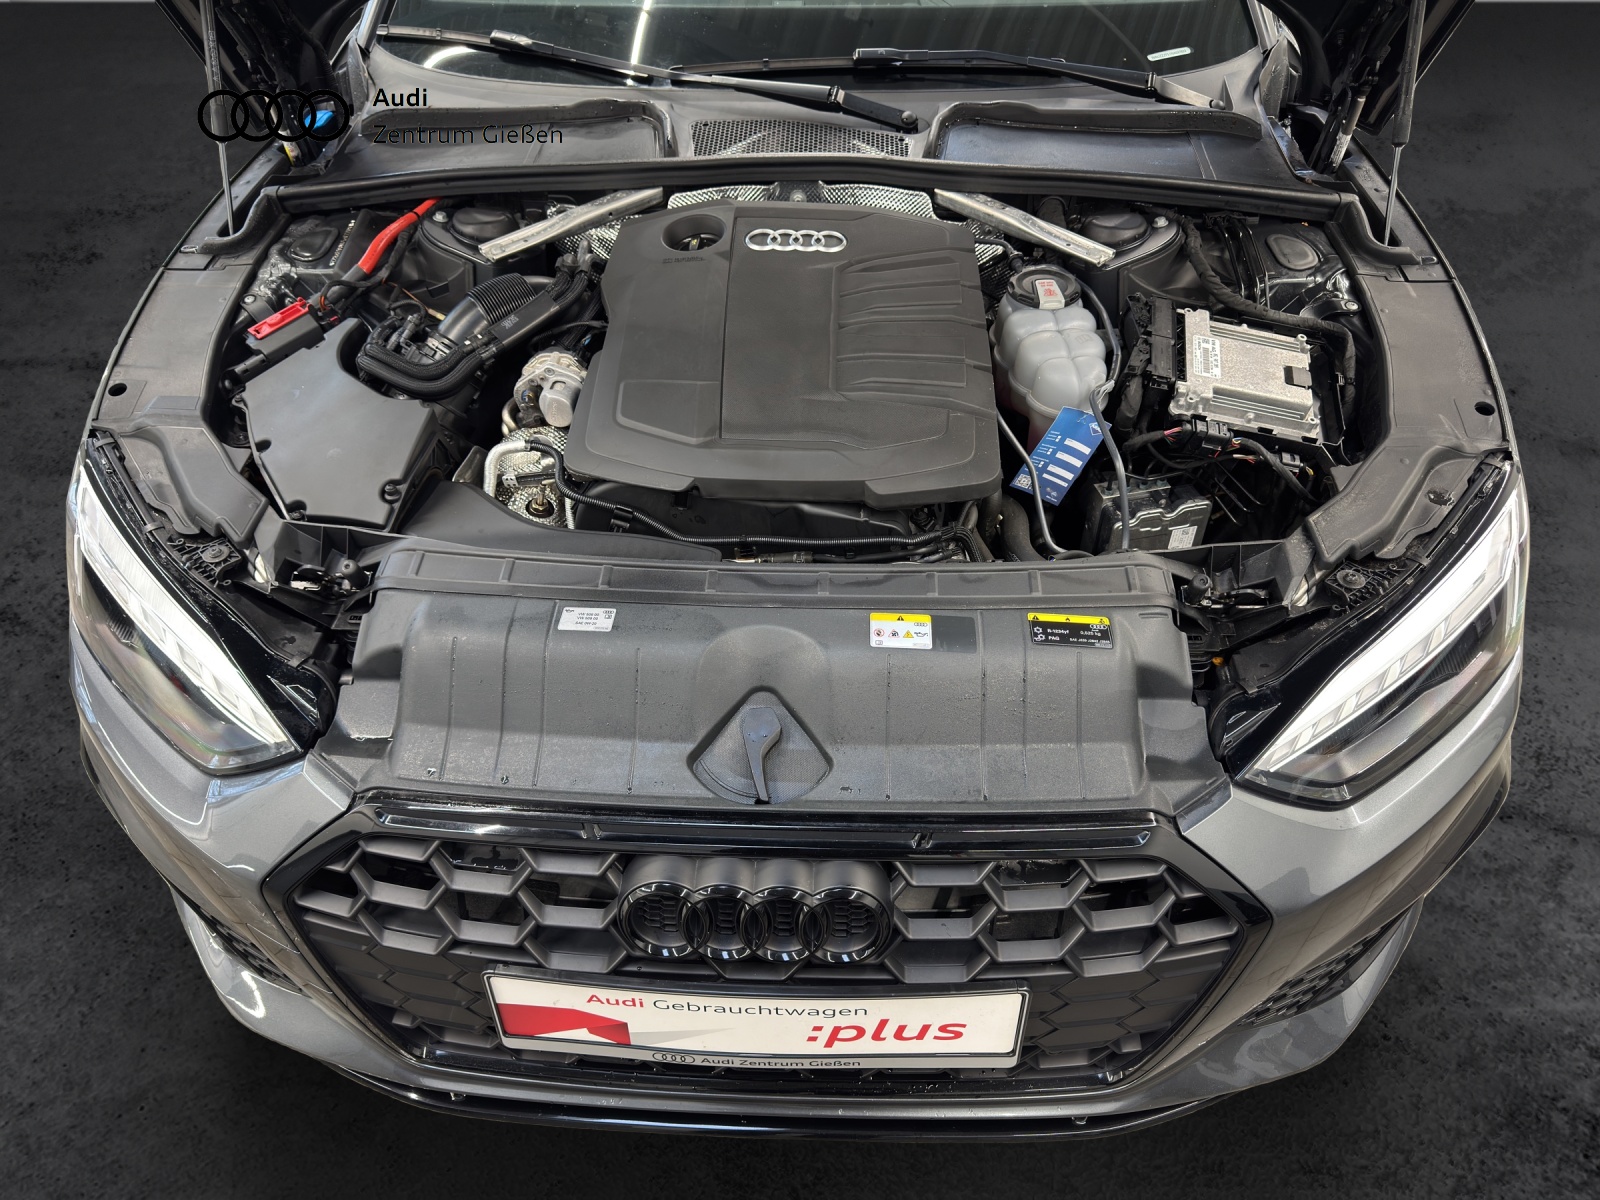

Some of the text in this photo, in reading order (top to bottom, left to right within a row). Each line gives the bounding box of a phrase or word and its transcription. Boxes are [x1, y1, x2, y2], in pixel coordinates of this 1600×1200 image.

[586, 994, 868, 1019] Audi Gebrauchtwagen
[700, 1057, 734, 1065] Audi
[739, 1059, 804, 1067] Zentrum
